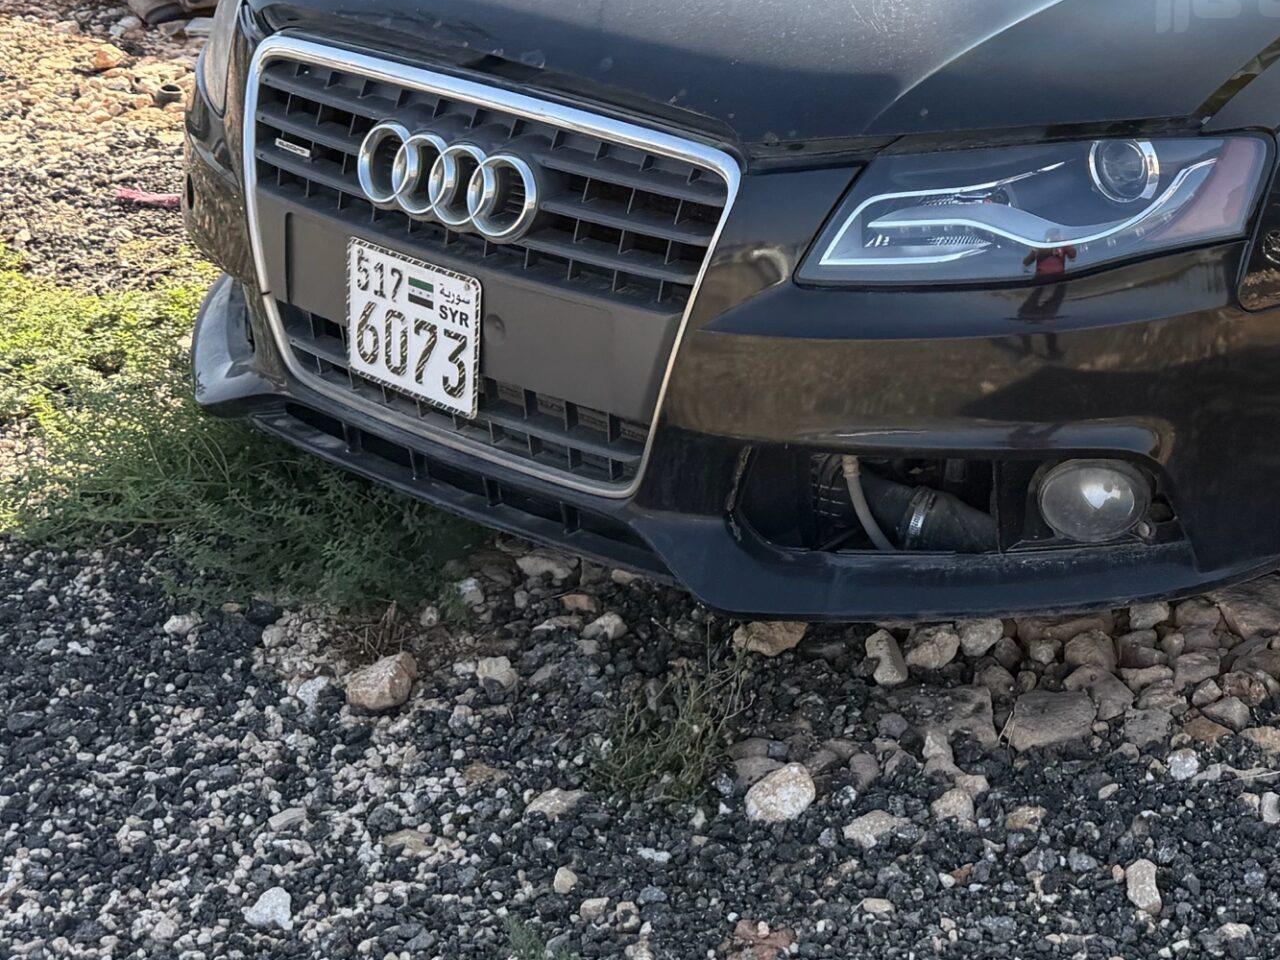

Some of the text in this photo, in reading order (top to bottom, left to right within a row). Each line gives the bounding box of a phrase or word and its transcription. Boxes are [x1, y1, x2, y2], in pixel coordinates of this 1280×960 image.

[357, 253, 403, 302] 517
[440, 283, 470, 305] سورية
[439, 305, 469, 328] SYR
[357, 301, 468, 399] 6073
